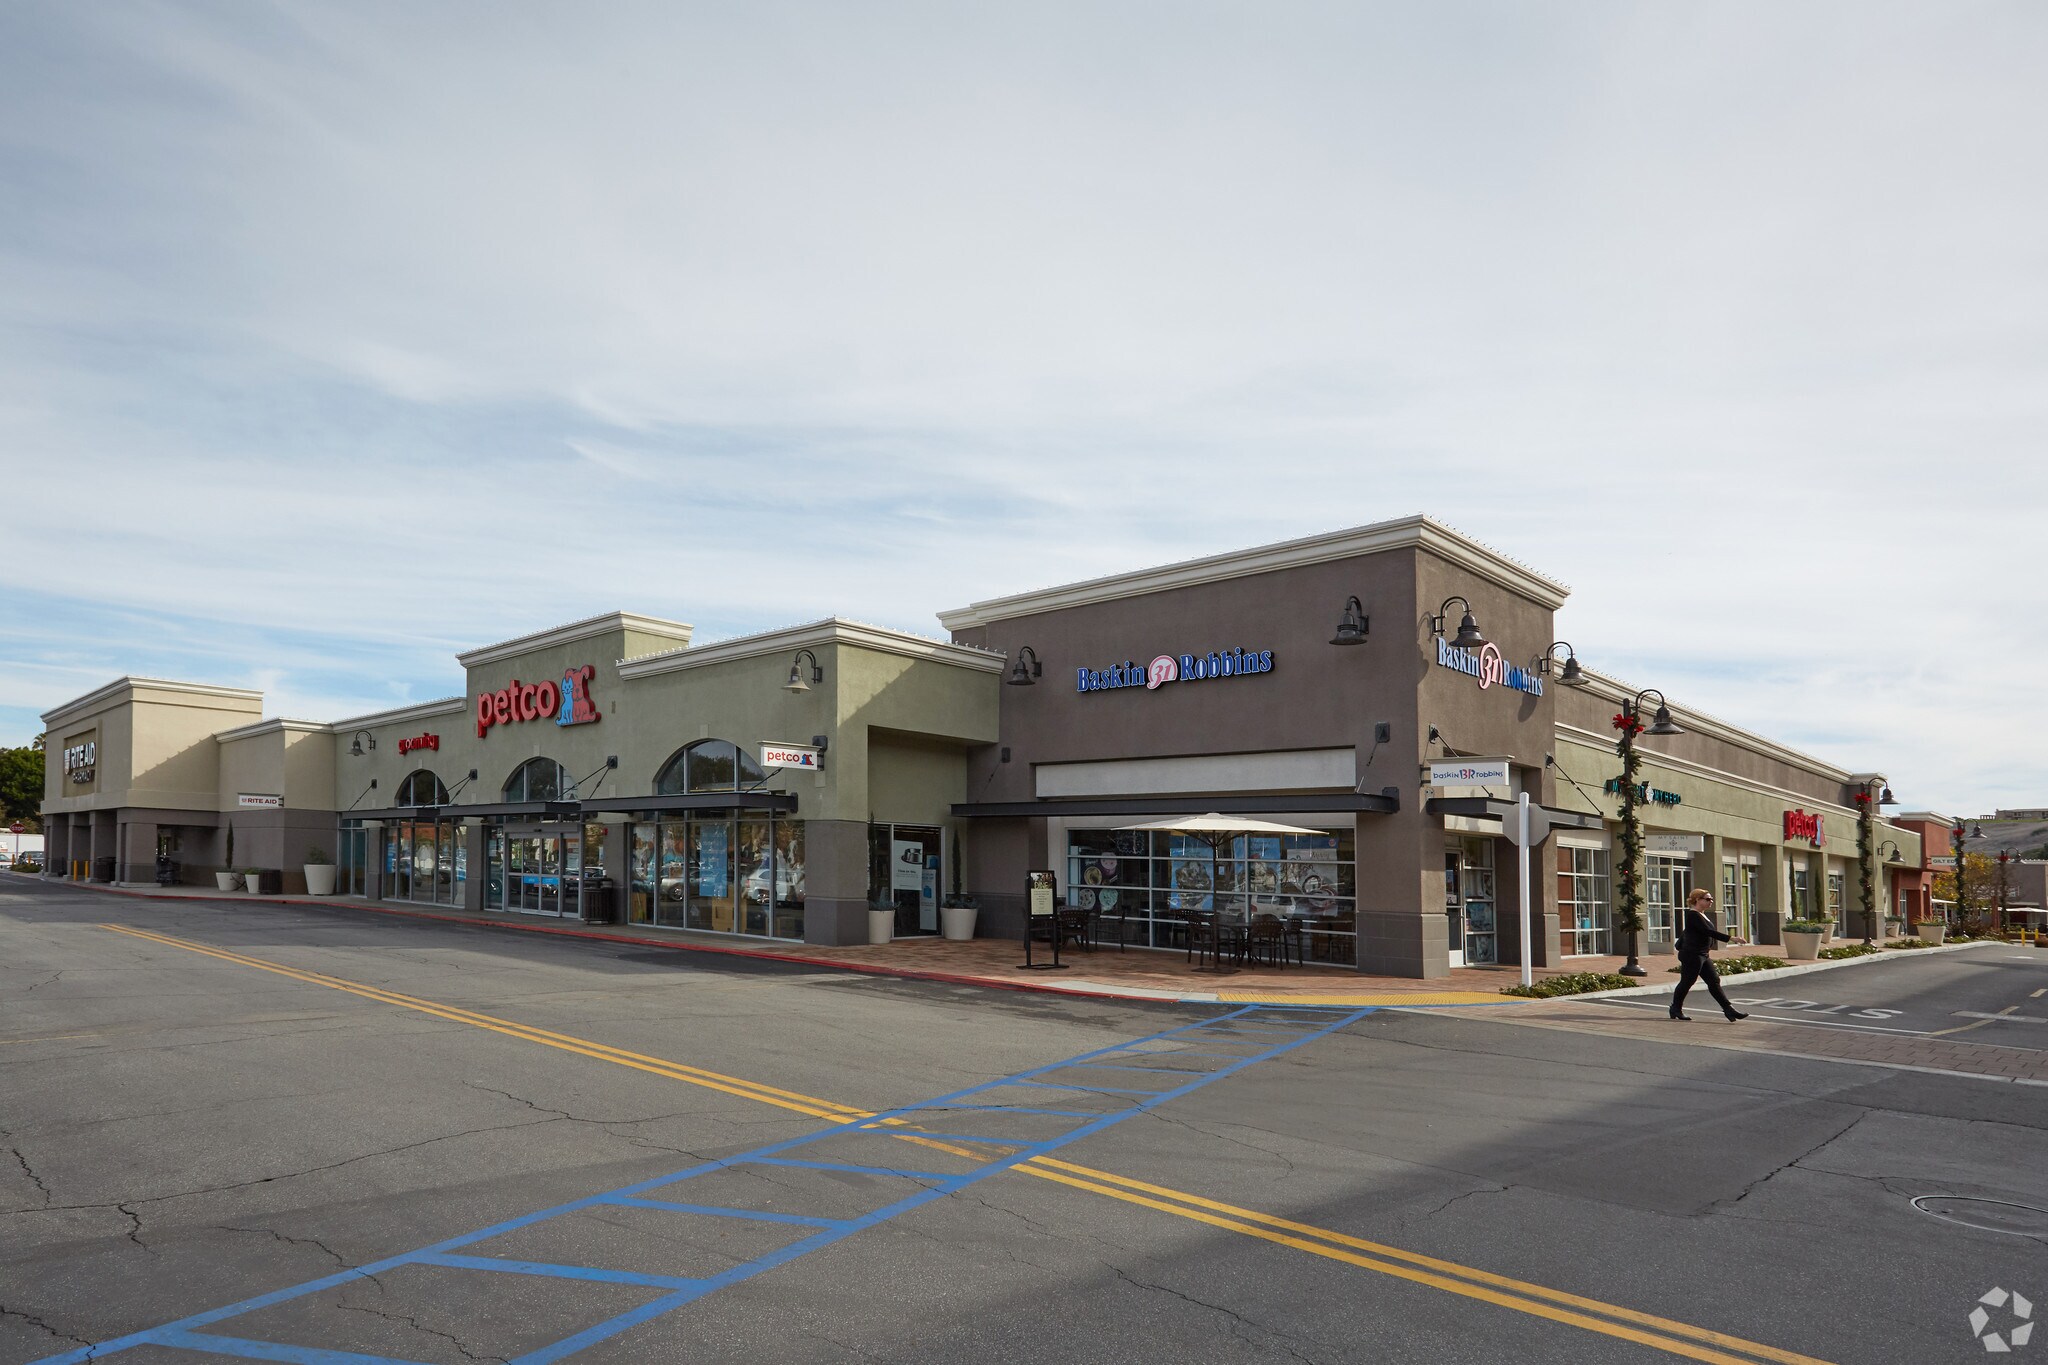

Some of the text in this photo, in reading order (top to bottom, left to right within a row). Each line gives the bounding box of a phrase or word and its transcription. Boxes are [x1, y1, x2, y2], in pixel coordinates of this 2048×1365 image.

[1077, 661, 1146, 692] Baskin
[1179, 647, 1272, 681] Robbins
[1437, 637, 1480, 677] Baskin
[1503, 660, 1543, 697] Robbins
[477, 680, 559, 738] petco
[71, 741, 96, 768] RITE AID
[767, 751, 800, 762] petco
[1433, 768, 1503, 780] baskin BR robbins
[1784, 809, 1816, 840] petco
[1727, 997, 1903, 1019] STOP
